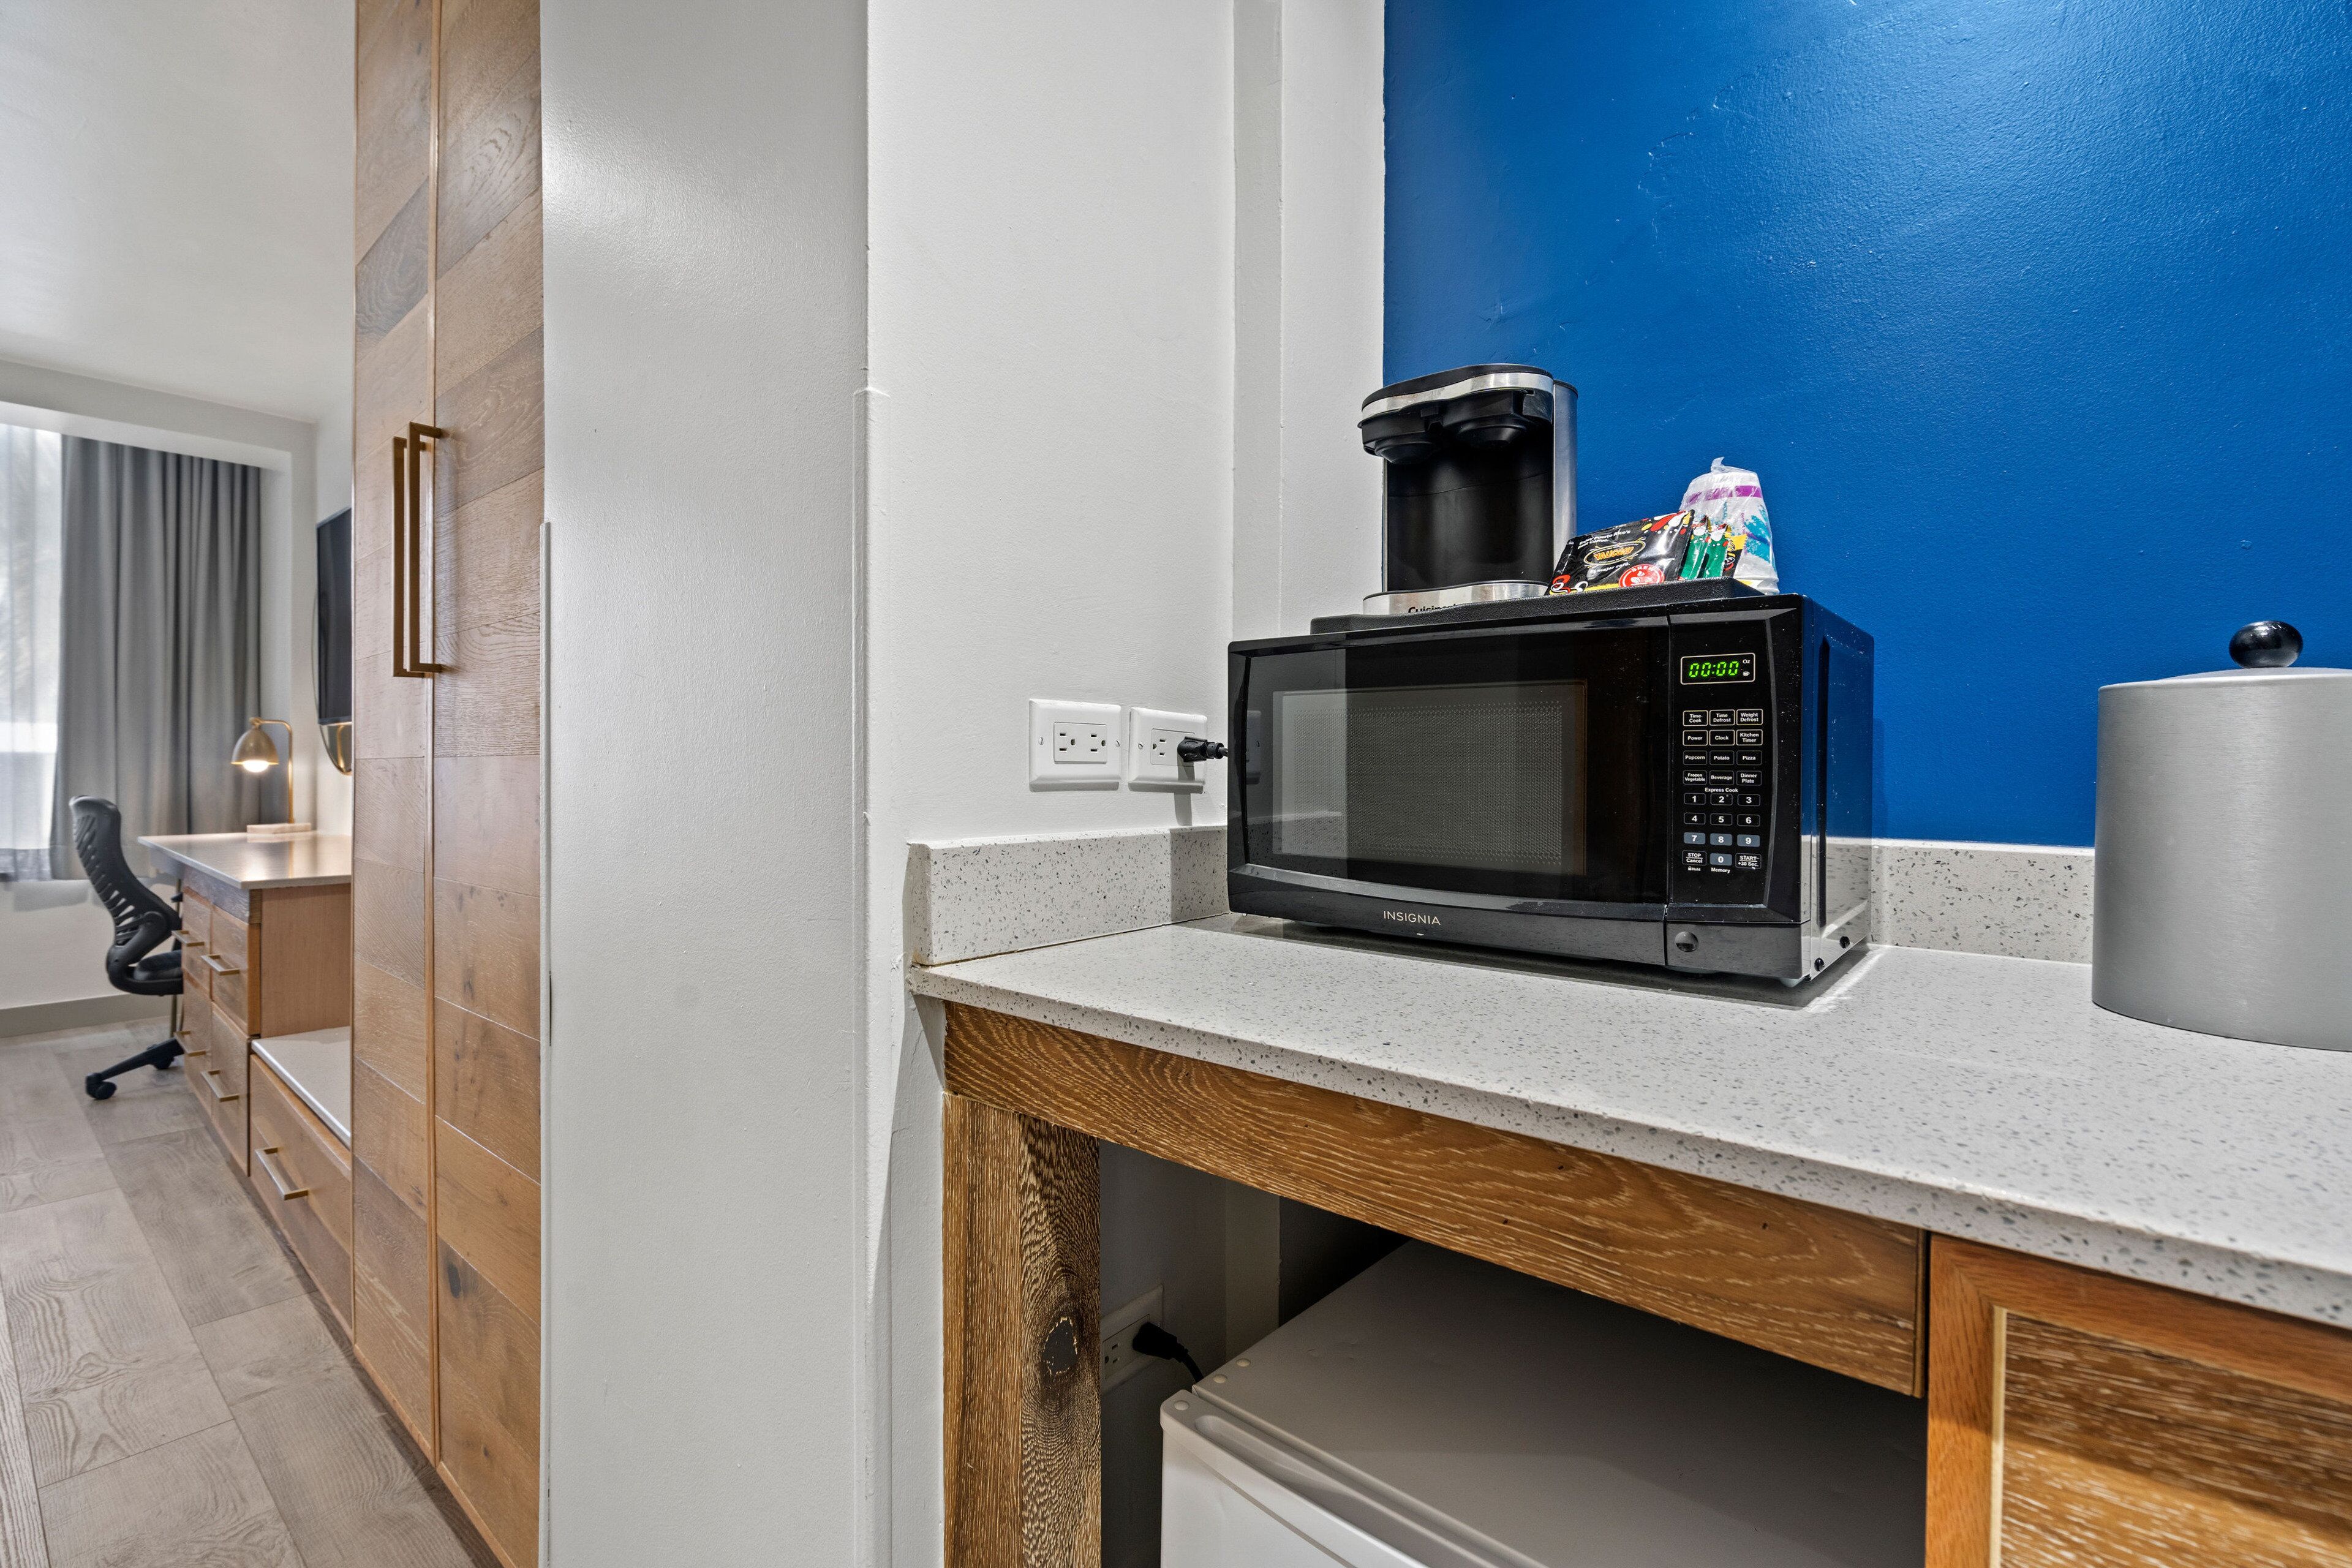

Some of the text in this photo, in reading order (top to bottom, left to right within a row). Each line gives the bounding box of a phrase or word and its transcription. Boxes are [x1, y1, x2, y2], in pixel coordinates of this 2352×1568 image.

[1408, 603, 1457, 613] Cuisi
[1689, 661, 1739, 677] 00:00
[1383, 910, 1441, 925] INSIGNIA
